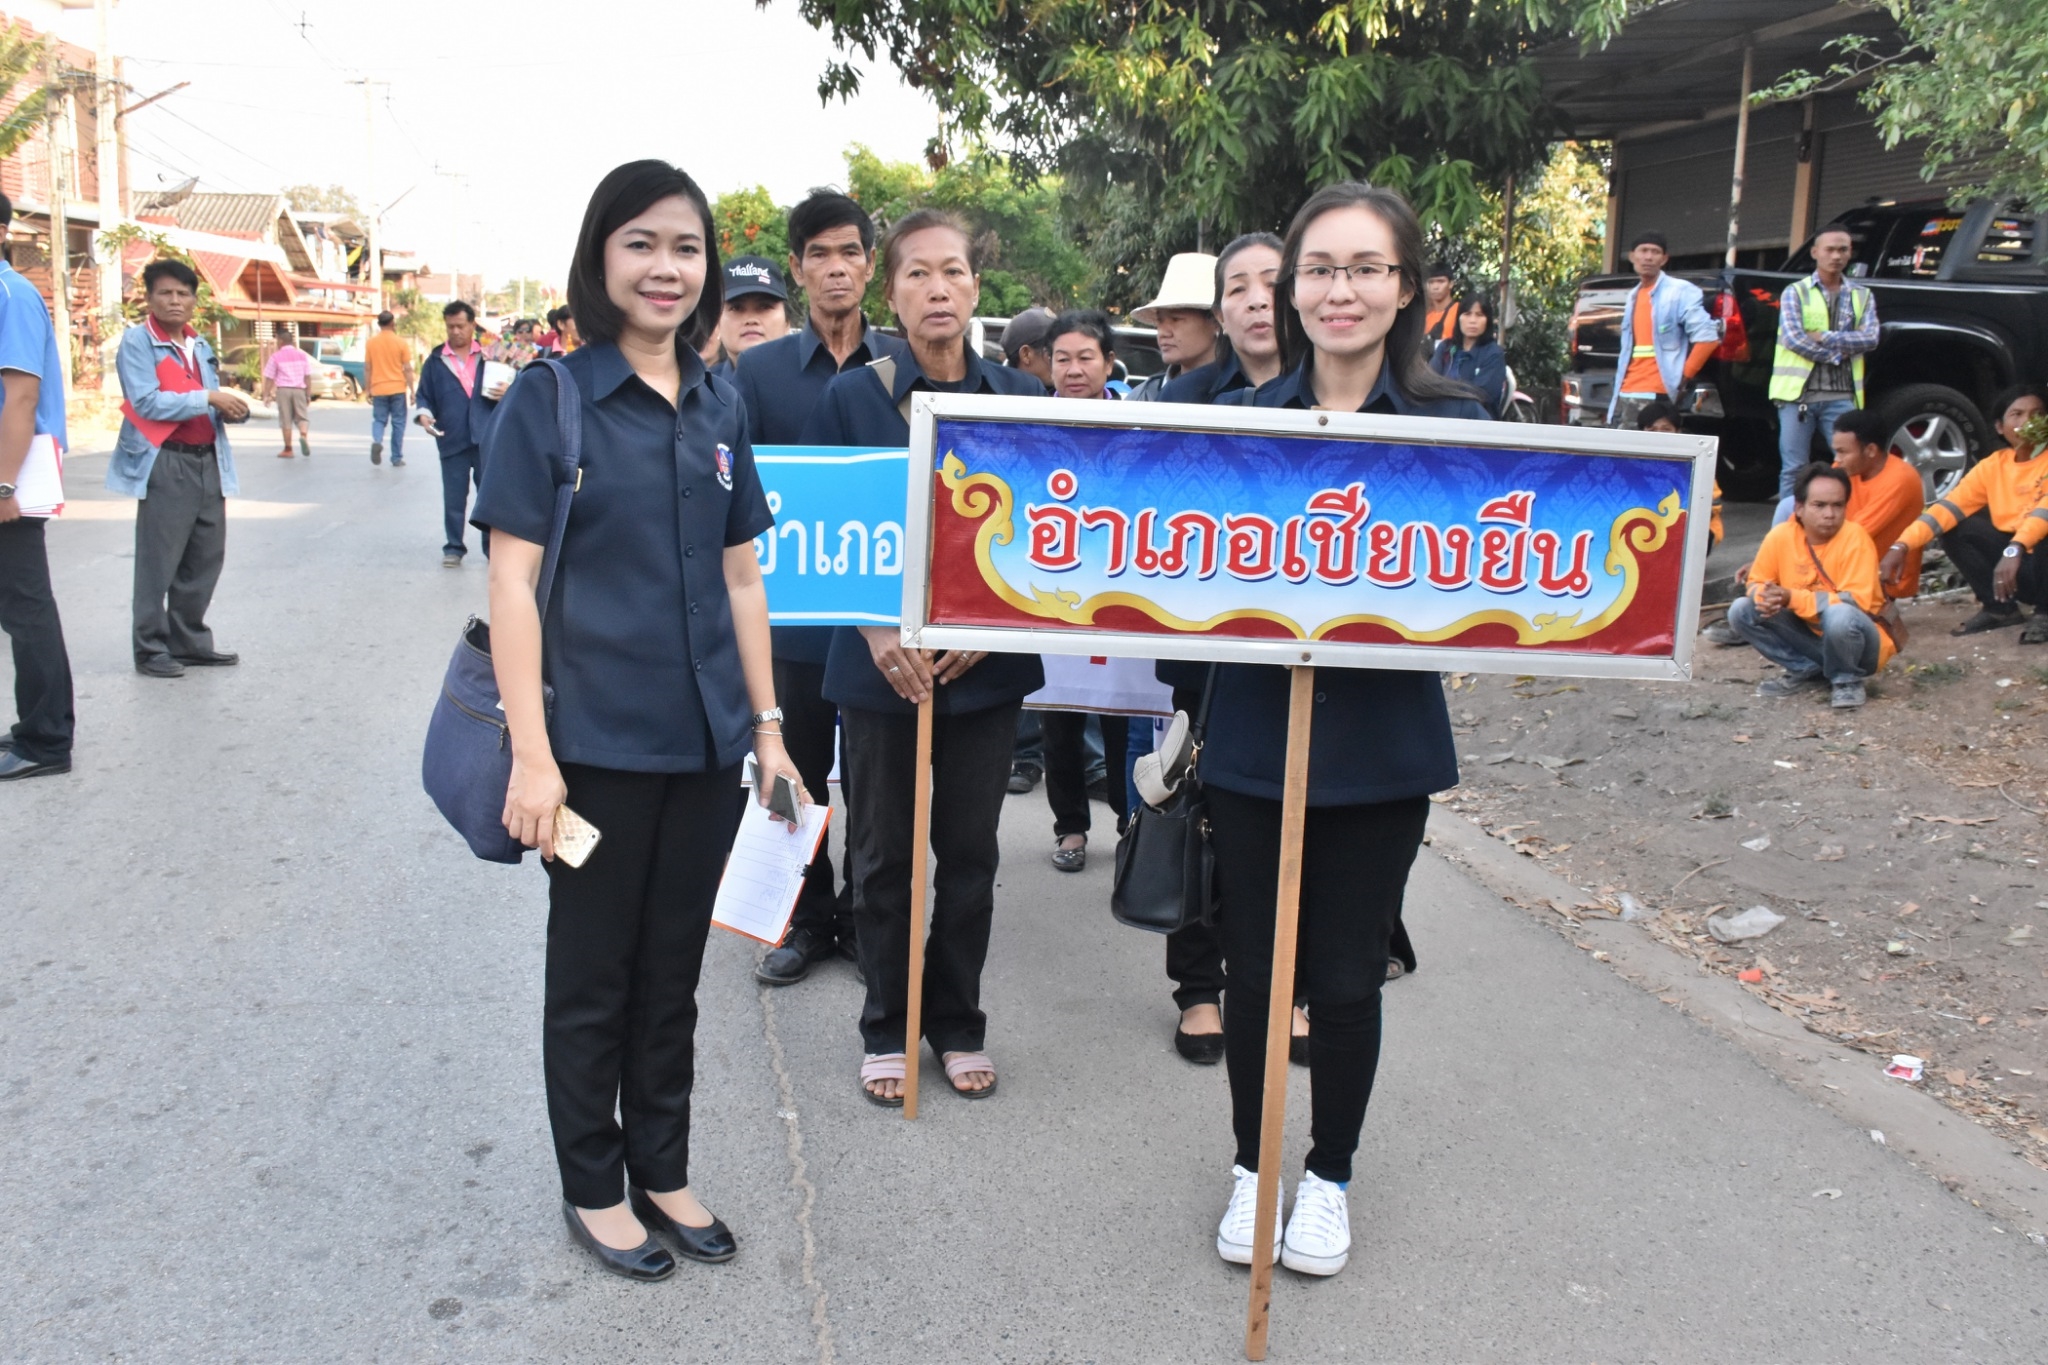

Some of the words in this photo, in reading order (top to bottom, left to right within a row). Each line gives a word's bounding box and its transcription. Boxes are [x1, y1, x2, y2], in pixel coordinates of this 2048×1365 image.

[1025, 469, 1592, 596] อำเภอเชียงยืน
